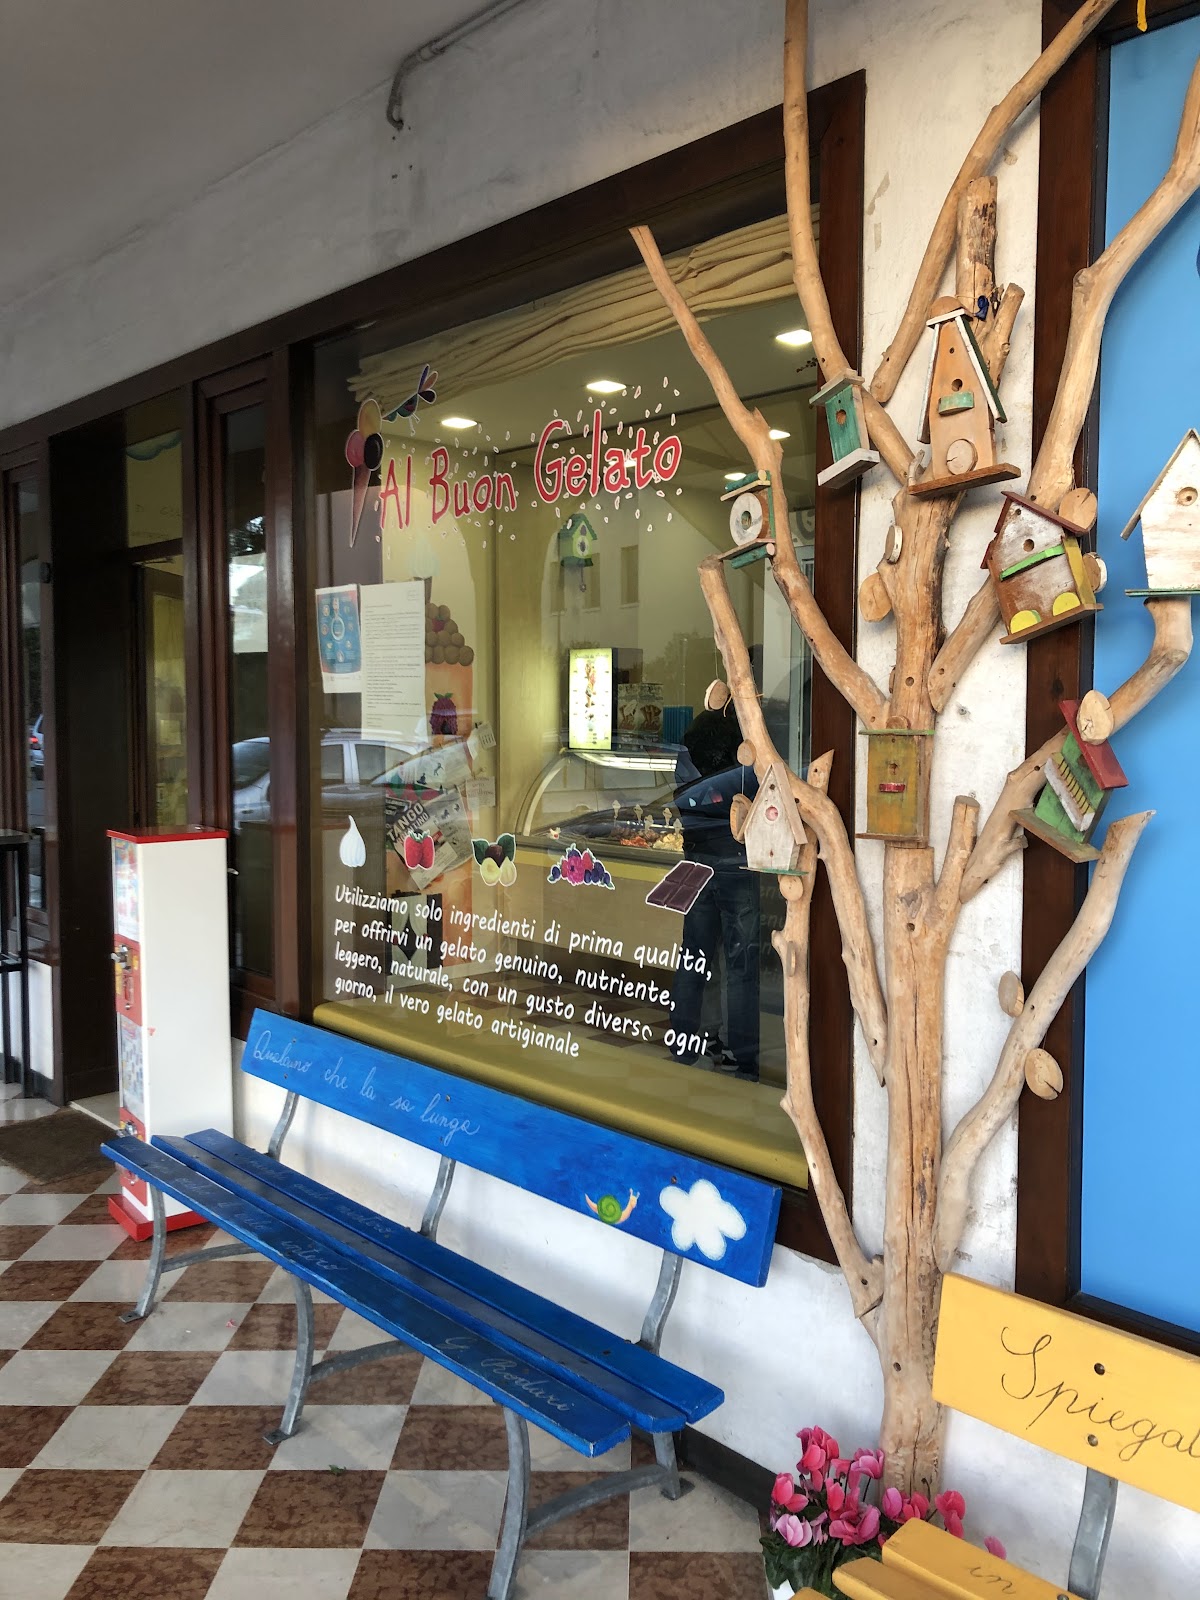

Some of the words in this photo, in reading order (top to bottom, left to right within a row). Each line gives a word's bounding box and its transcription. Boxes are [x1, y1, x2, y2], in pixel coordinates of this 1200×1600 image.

[379, 455, 413, 530] Al
[428, 446, 518, 525] Buon
[533, 408, 682, 504] Gelato
[386, 802, 424, 841] TANGO
[334, 917, 357, 937] per
[361, 921, 409, 948] offrirvi
[415, 934, 433, 951] un
[439, 937, 488, 963] gelato
[494, 950, 564, 986] genuino,
[575, 968, 676, 1012] nutriente,
[335, 884, 408, 916] Utilizziamo
[414, 903, 443, 922] solo
[449, 904, 536, 941] ingredienti
[543, 919, 560, 945] di
[568, 930, 624, 960] prima
[633, 942, 713, 982] qualità,
[334, 940, 383, 975] leggero,
[390, 960, 453, 993] naturale,
[462, 976, 489, 998] con
[497, 985, 518, 1006] un
[525, 991, 576, 1020] gusto
[664, 1028, 711, 1057] ogni
[334, 976, 377, 1003] giorno,
[384, 984, 394, 1005] il
[400, 993, 430, 1014] vero
[437, 1004, 484, 1030] gelato
[491, 1017, 580, 1058] artigianale
[324, 1056, 349, 1090] che
[359, 1066, 377, 1101] la
[419, 1093, 481, 1147] lunga
[480, 1358, 575, 1412] Rodari
